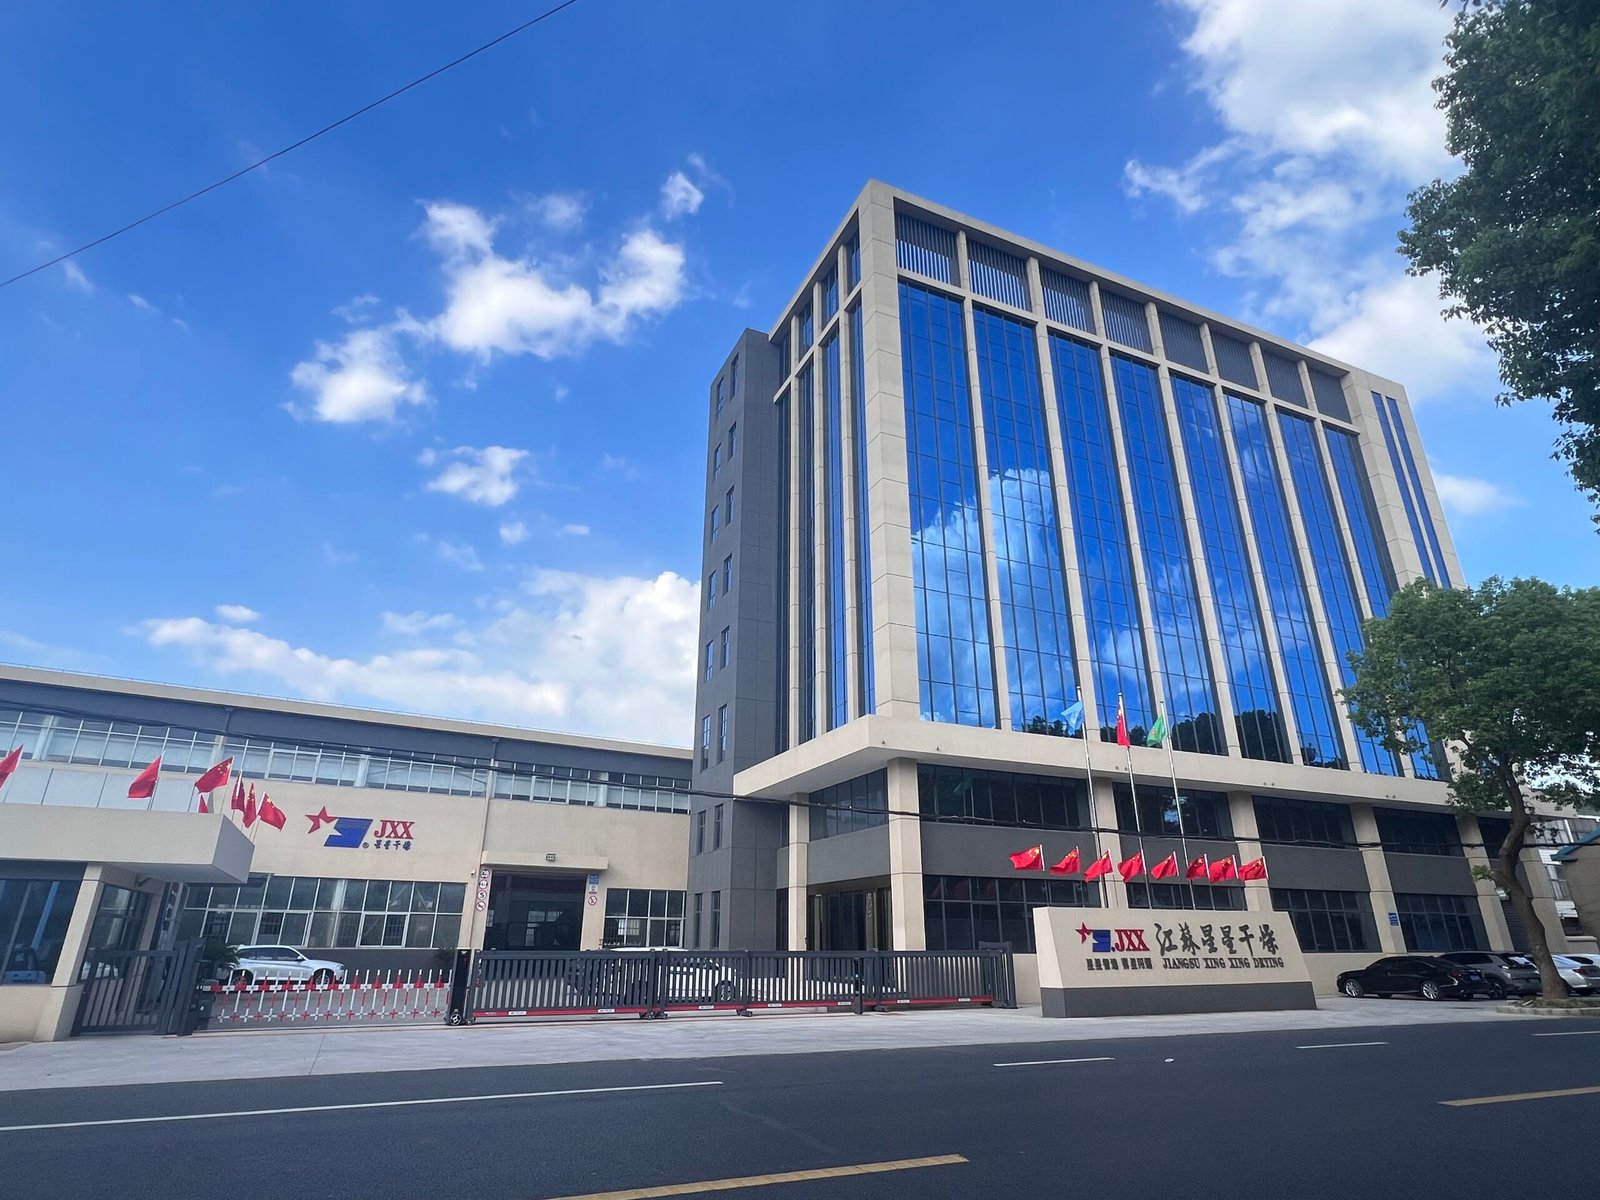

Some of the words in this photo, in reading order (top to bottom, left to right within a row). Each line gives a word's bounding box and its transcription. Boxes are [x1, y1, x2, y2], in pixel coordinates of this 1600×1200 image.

[374, 819, 415, 840] JXX
[1114, 929, 1151, 952] JXX
[1163, 957, 1200, 969] JIANGSU
[1203, 957, 1226, 969] XING
[1228, 957, 1251, 969] XING
[1252, 957, 1285, 968] DRYING
